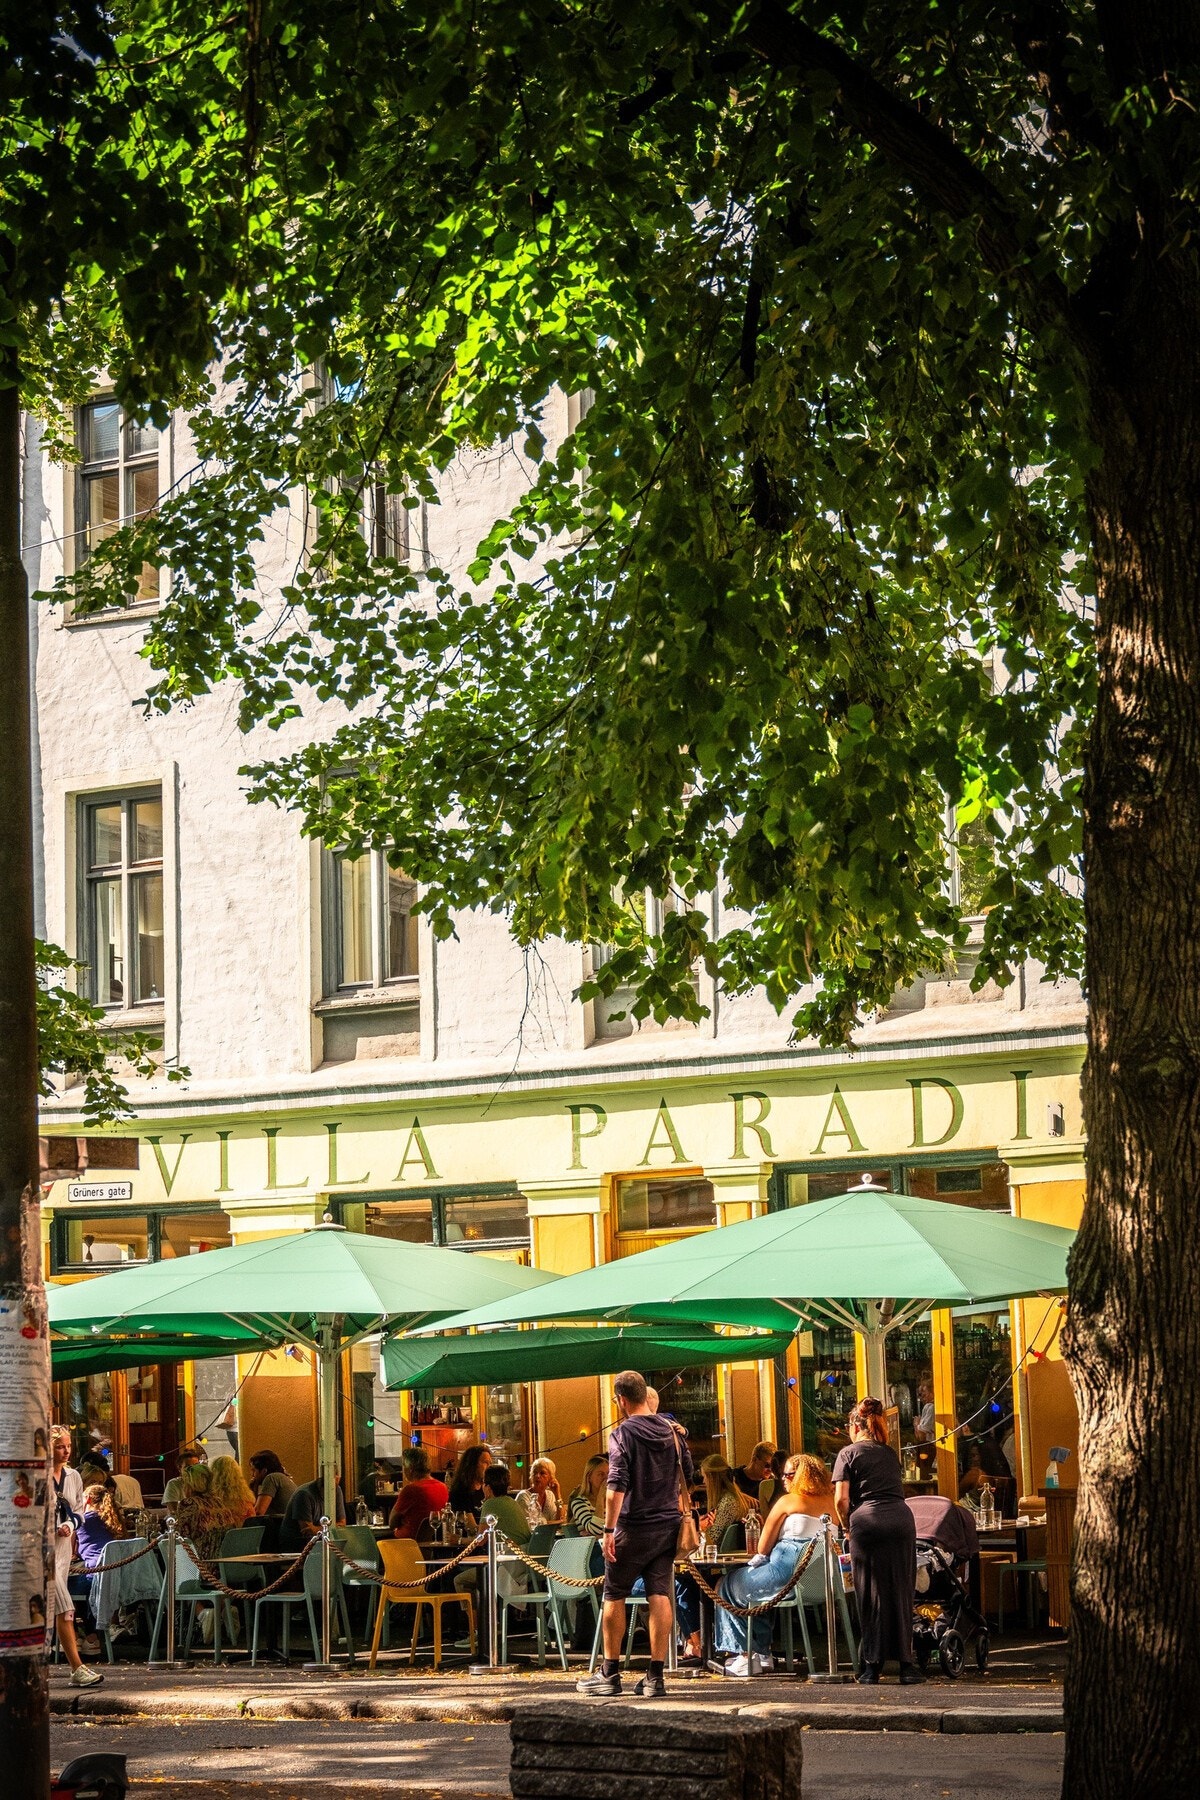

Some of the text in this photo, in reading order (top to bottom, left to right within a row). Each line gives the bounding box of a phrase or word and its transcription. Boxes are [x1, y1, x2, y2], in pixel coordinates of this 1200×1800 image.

[144, 1069, 1088, 1198] VILLA PARADI
[73, 1186, 126, 1198] Grüners gate
